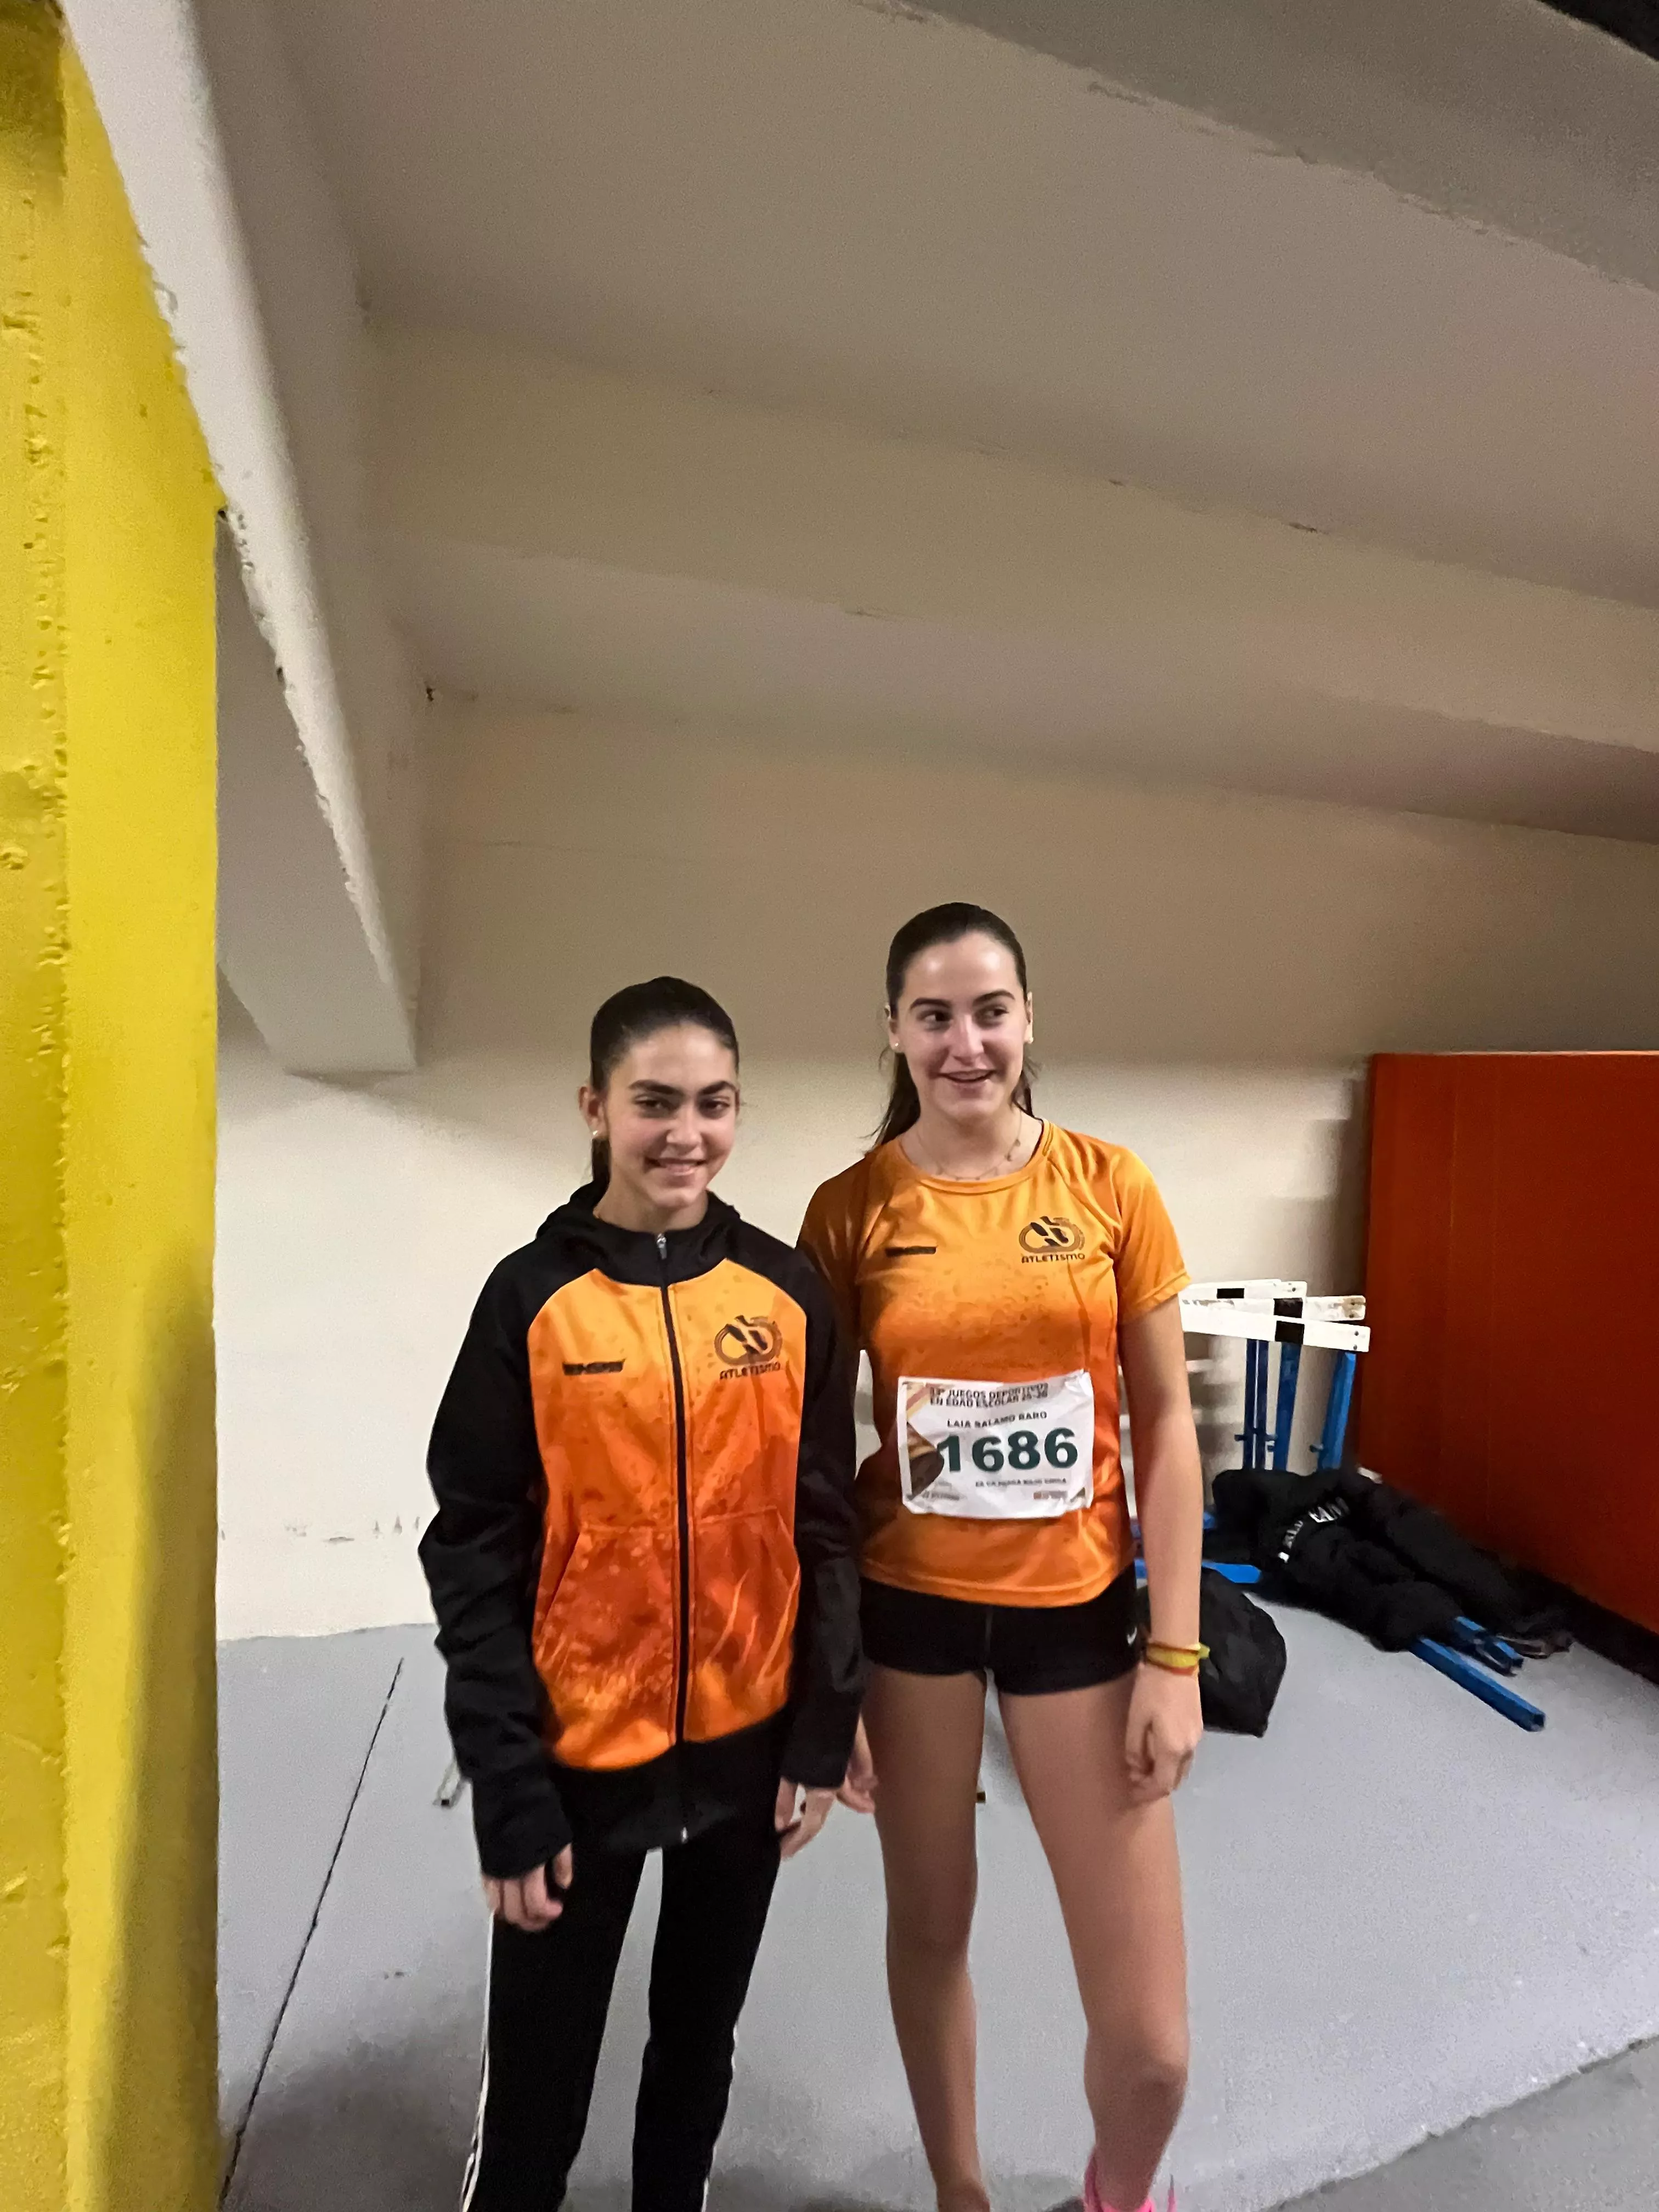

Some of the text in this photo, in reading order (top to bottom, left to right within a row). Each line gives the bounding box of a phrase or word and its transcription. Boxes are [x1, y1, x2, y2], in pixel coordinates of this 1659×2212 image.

[1021, 1253, 1085, 1263] ATLETISMO
[949, 1389, 986, 1400] JUEGOS
[946, 1397, 973, 1408] EDAD
[947, 1418, 971, 1428] LAIA
[937, 1427, 1078, 1472] 1686
